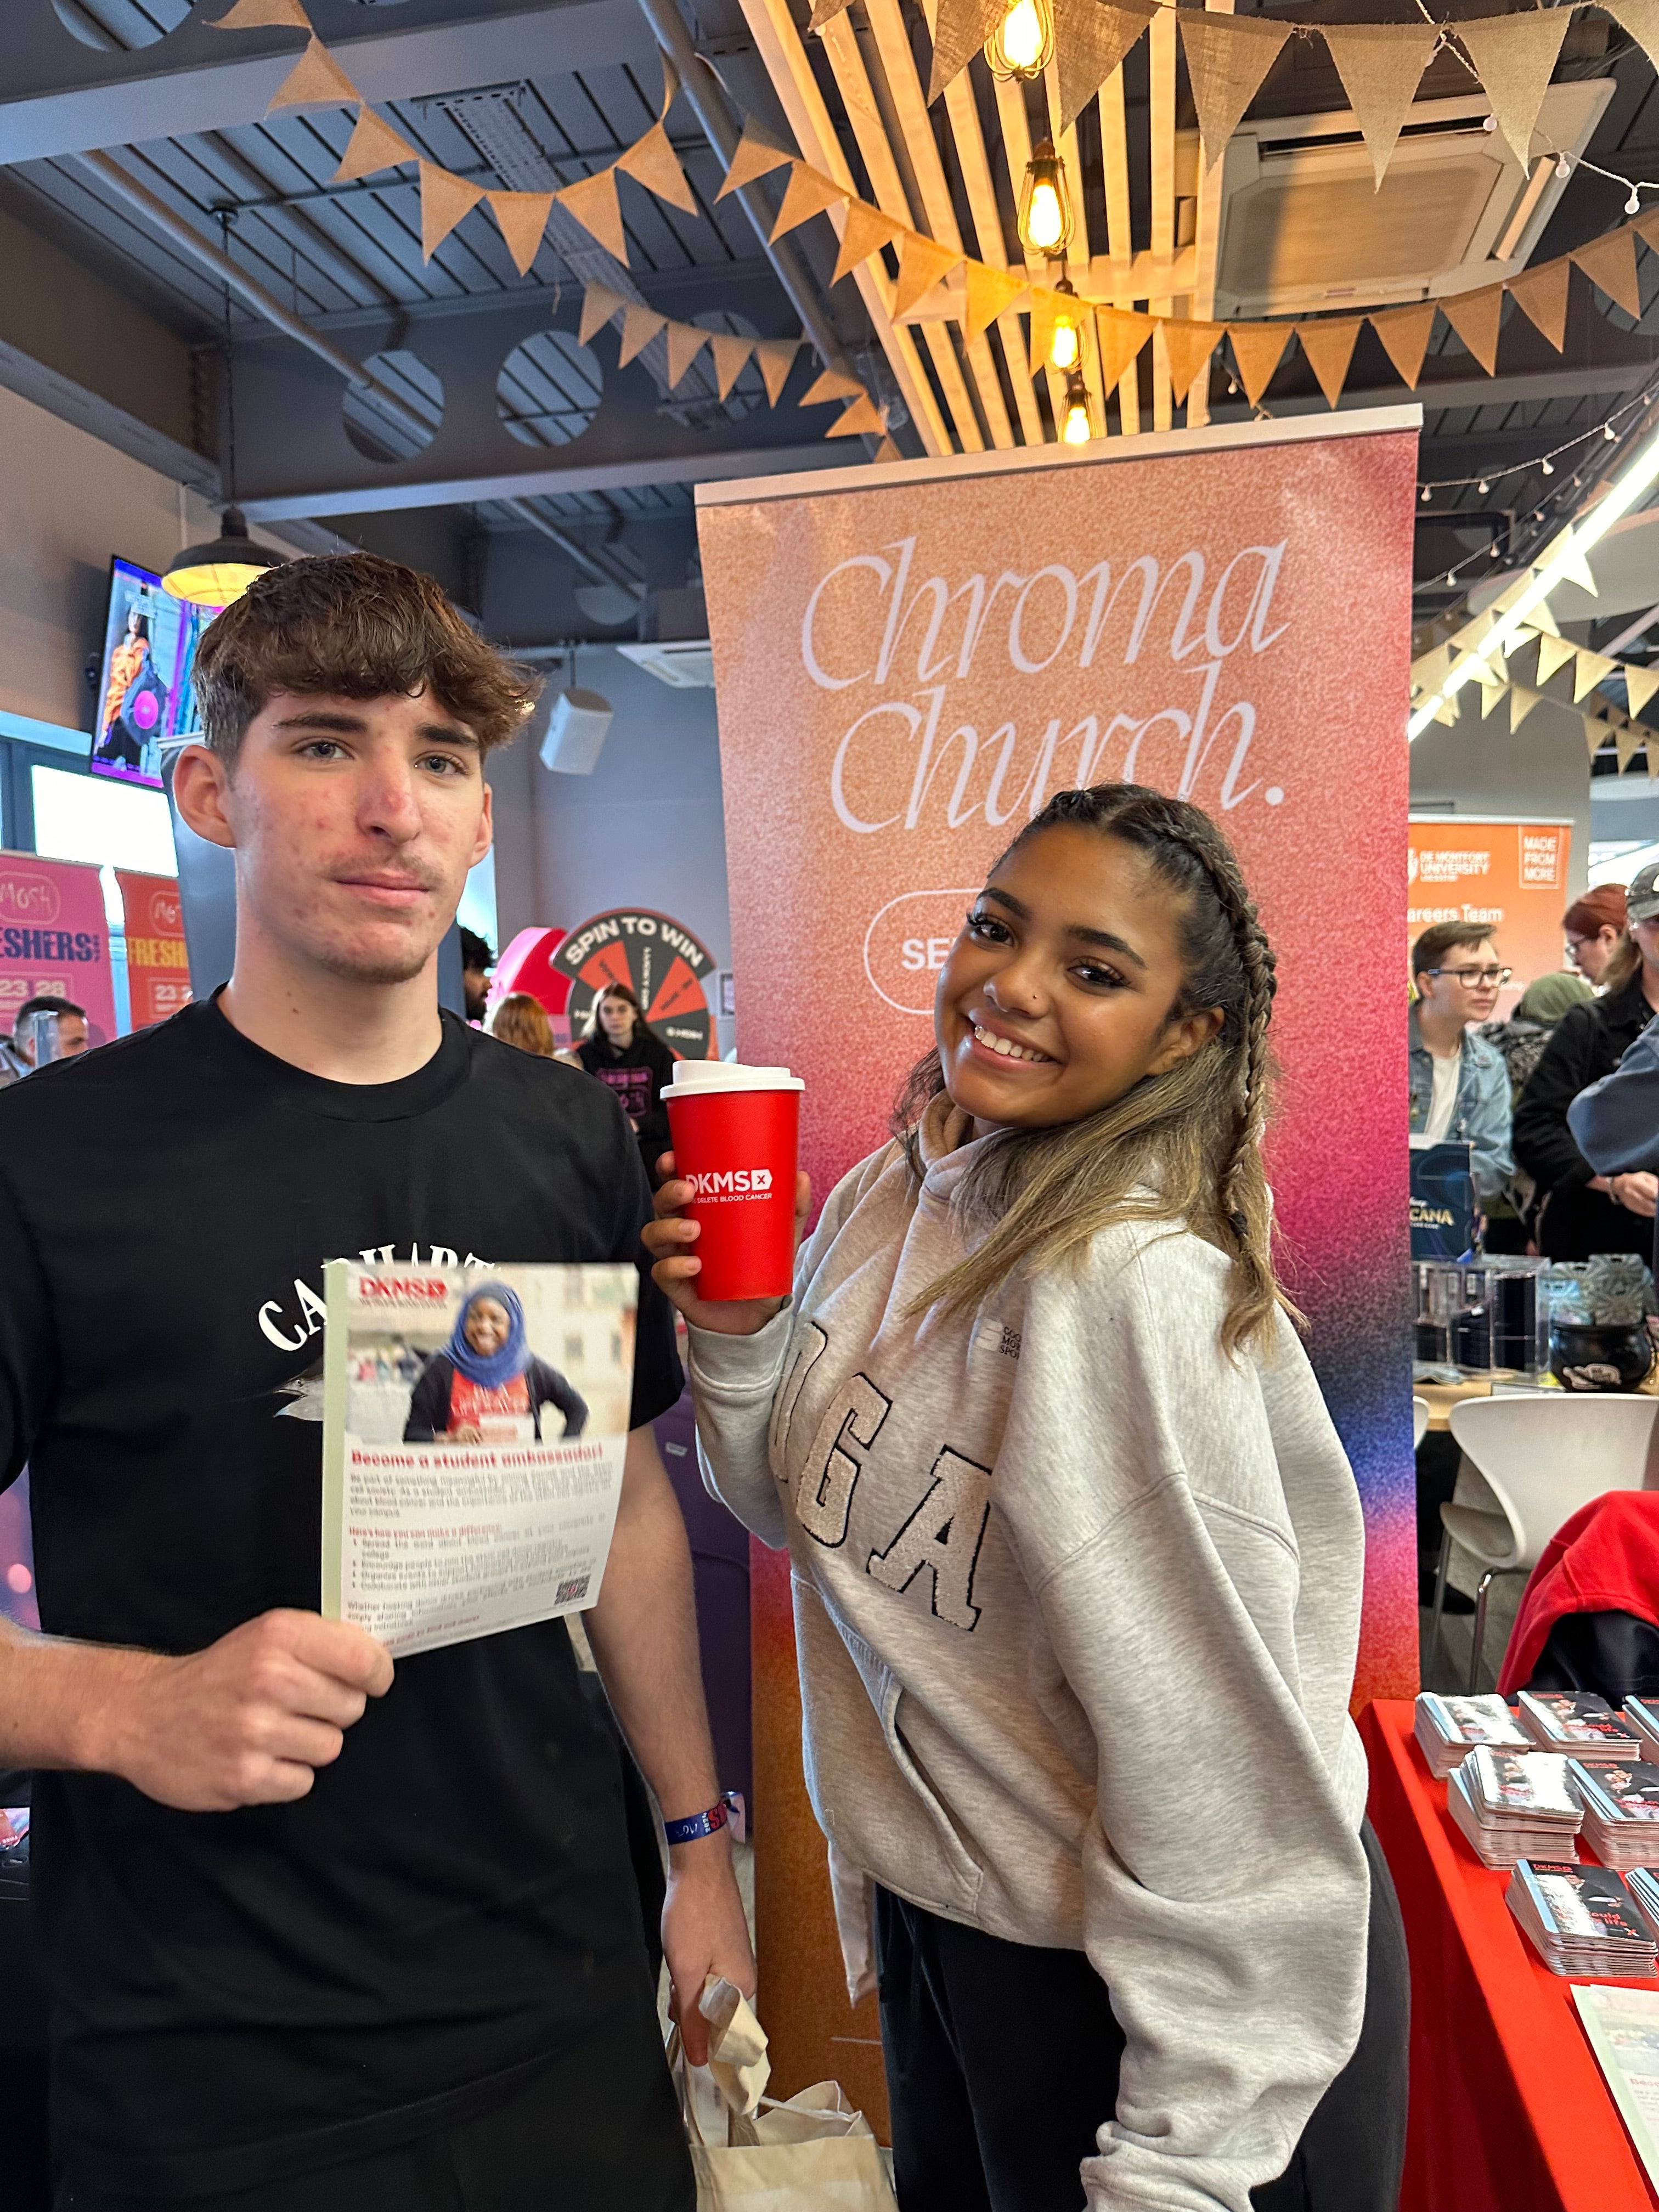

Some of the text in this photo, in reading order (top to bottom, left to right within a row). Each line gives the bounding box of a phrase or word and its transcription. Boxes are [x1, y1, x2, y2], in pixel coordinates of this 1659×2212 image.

[802, 537, 1292, 689] Chroma
[831, 659, 1283, 833] Church.
[1523, 836, 1557, 850] MADE
[1523, 852, 1555, 865] FROM
[1420, 864, 1491, 874] UNIVERSITY
[1523, 867, 1555, 881] MORE
[1407, 903, 1504, 923] areers Team
[127, 936, 188, 968] FRESH
[565, 917, 704, 967] SPIN TO WIN
[901, 938, 958, 970] SE
[685, 1170, 751, 1194] DKMS
[697, 1196, 719, 1204] DELETE
[720, 1194, 744, 1203] BLOOD
[1409, 1207, 1455, 1226] CANA
[352, 1449, 415, 1468] Become
[433, 1450, 496, 1470] student
